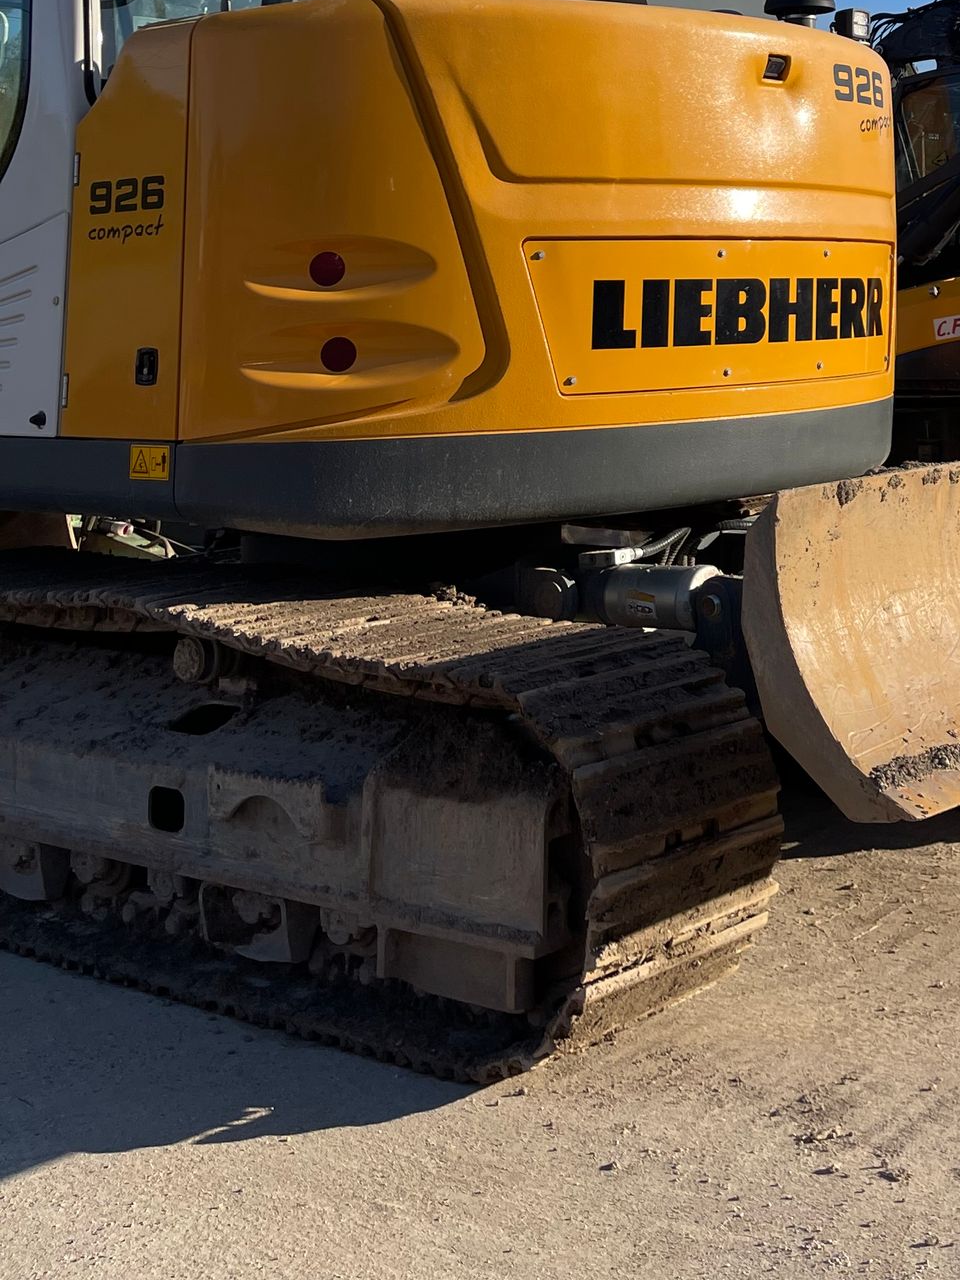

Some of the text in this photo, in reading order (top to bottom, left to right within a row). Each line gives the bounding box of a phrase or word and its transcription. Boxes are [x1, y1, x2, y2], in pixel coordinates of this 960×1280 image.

[833, 63, 884, 108] 926
[89, 175, 165, 215] 926
[88, 214, 164, 245] compact
[591, 277, 883, 350] LIEBHERR
